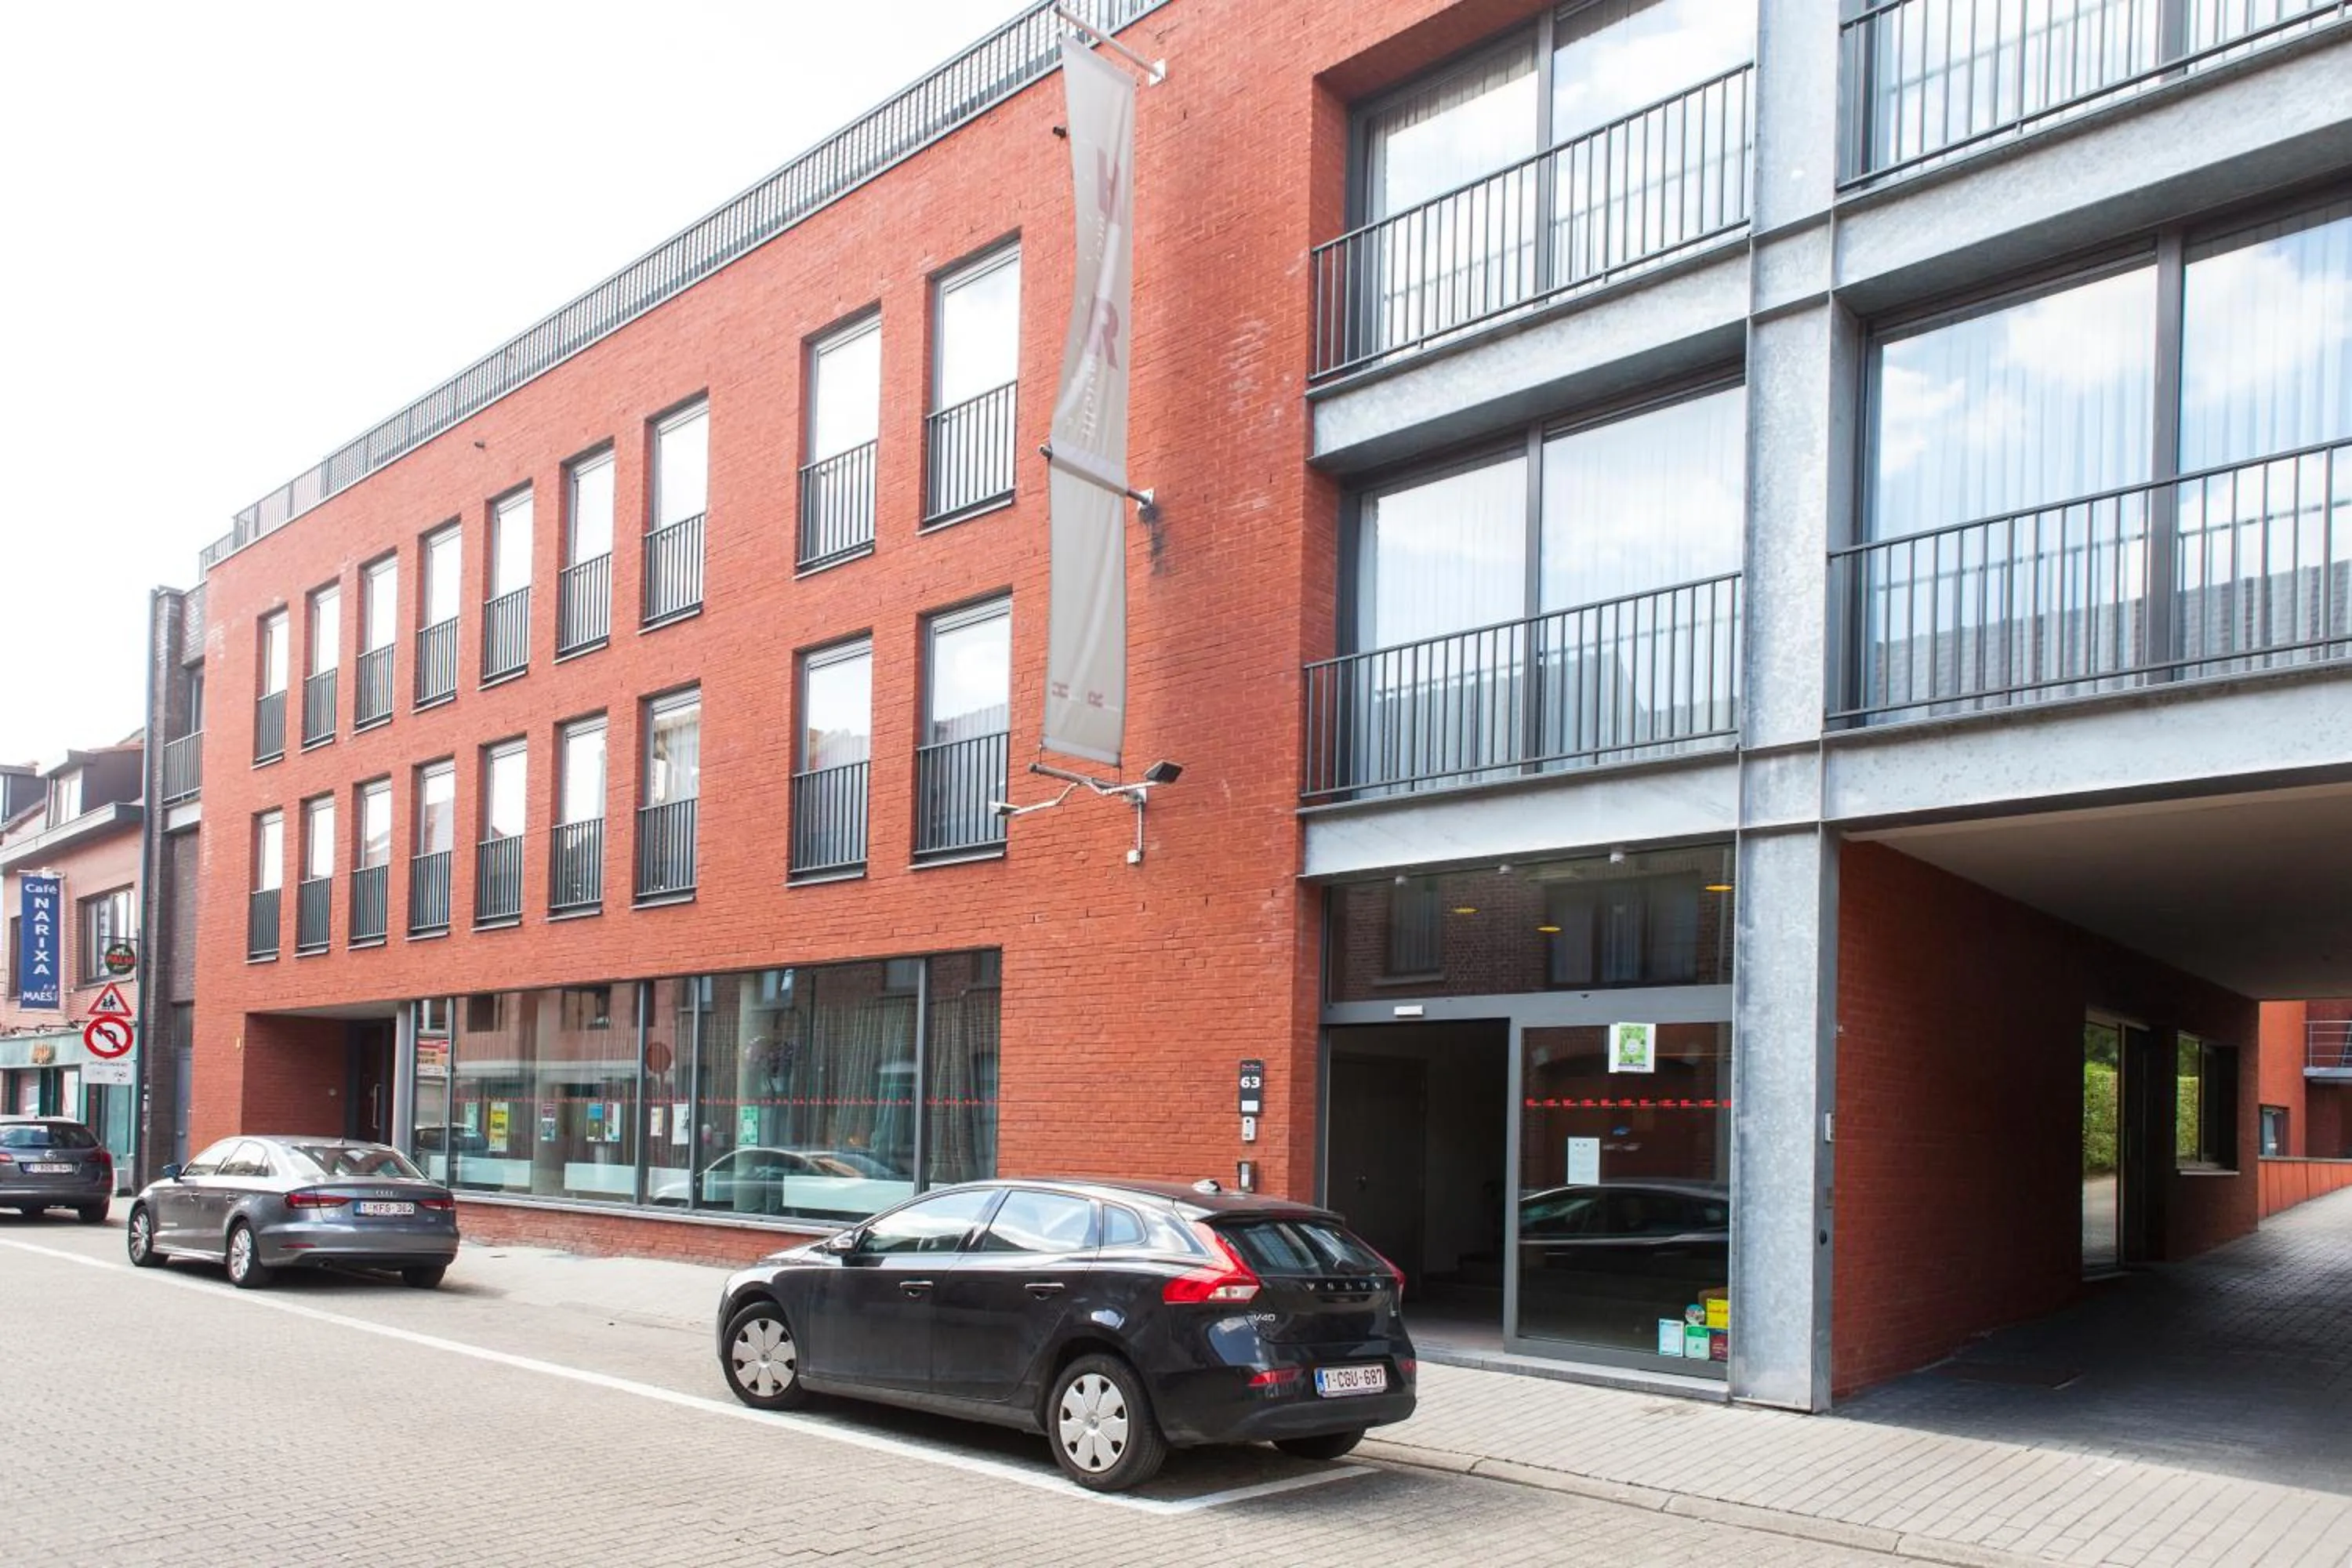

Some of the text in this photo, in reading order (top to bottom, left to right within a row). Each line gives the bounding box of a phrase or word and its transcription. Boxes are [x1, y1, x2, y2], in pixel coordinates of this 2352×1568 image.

[25, 884, 57, 895] Café
[33, 898, 50, 975] NARIXA
[23, 991, 52, 1001] MAES
[1241, 1076, 1260, 1088] 63
[1254, 1313, 1276, 1322] V40
